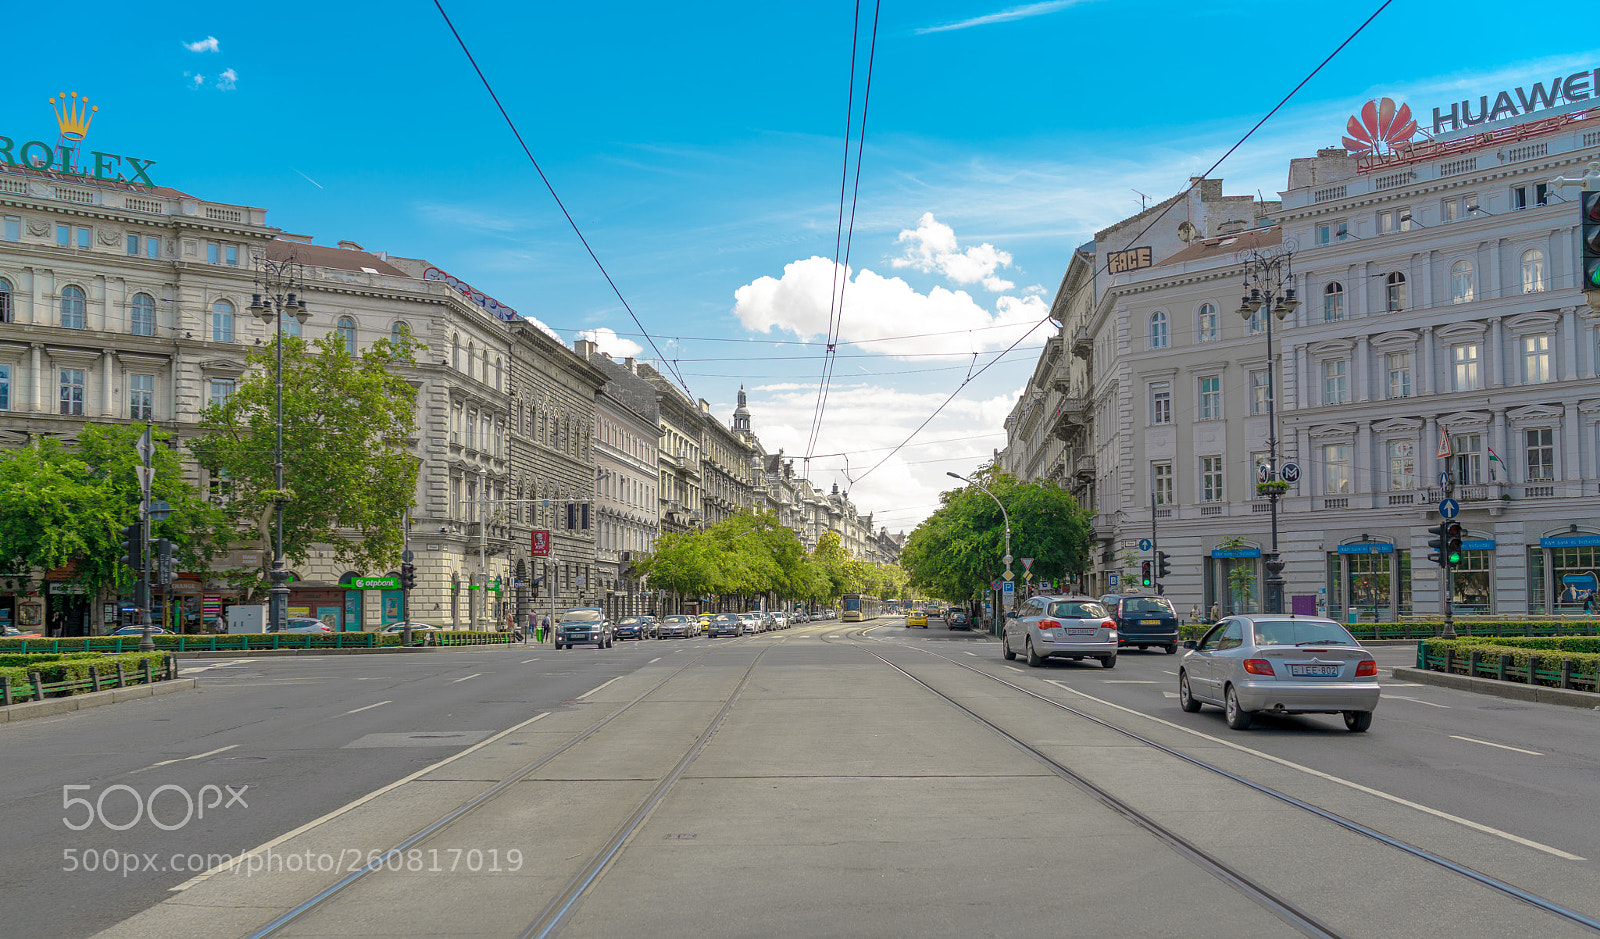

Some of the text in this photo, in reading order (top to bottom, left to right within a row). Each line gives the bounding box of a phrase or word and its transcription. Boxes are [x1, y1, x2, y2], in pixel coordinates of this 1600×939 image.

[0, 136, 158, 188] ROLEX
[1107, 247, 1152, 275] FACE
[365, 578, 394, 588] otpbank
[1301, 666, 1337, 675] IEE-802
